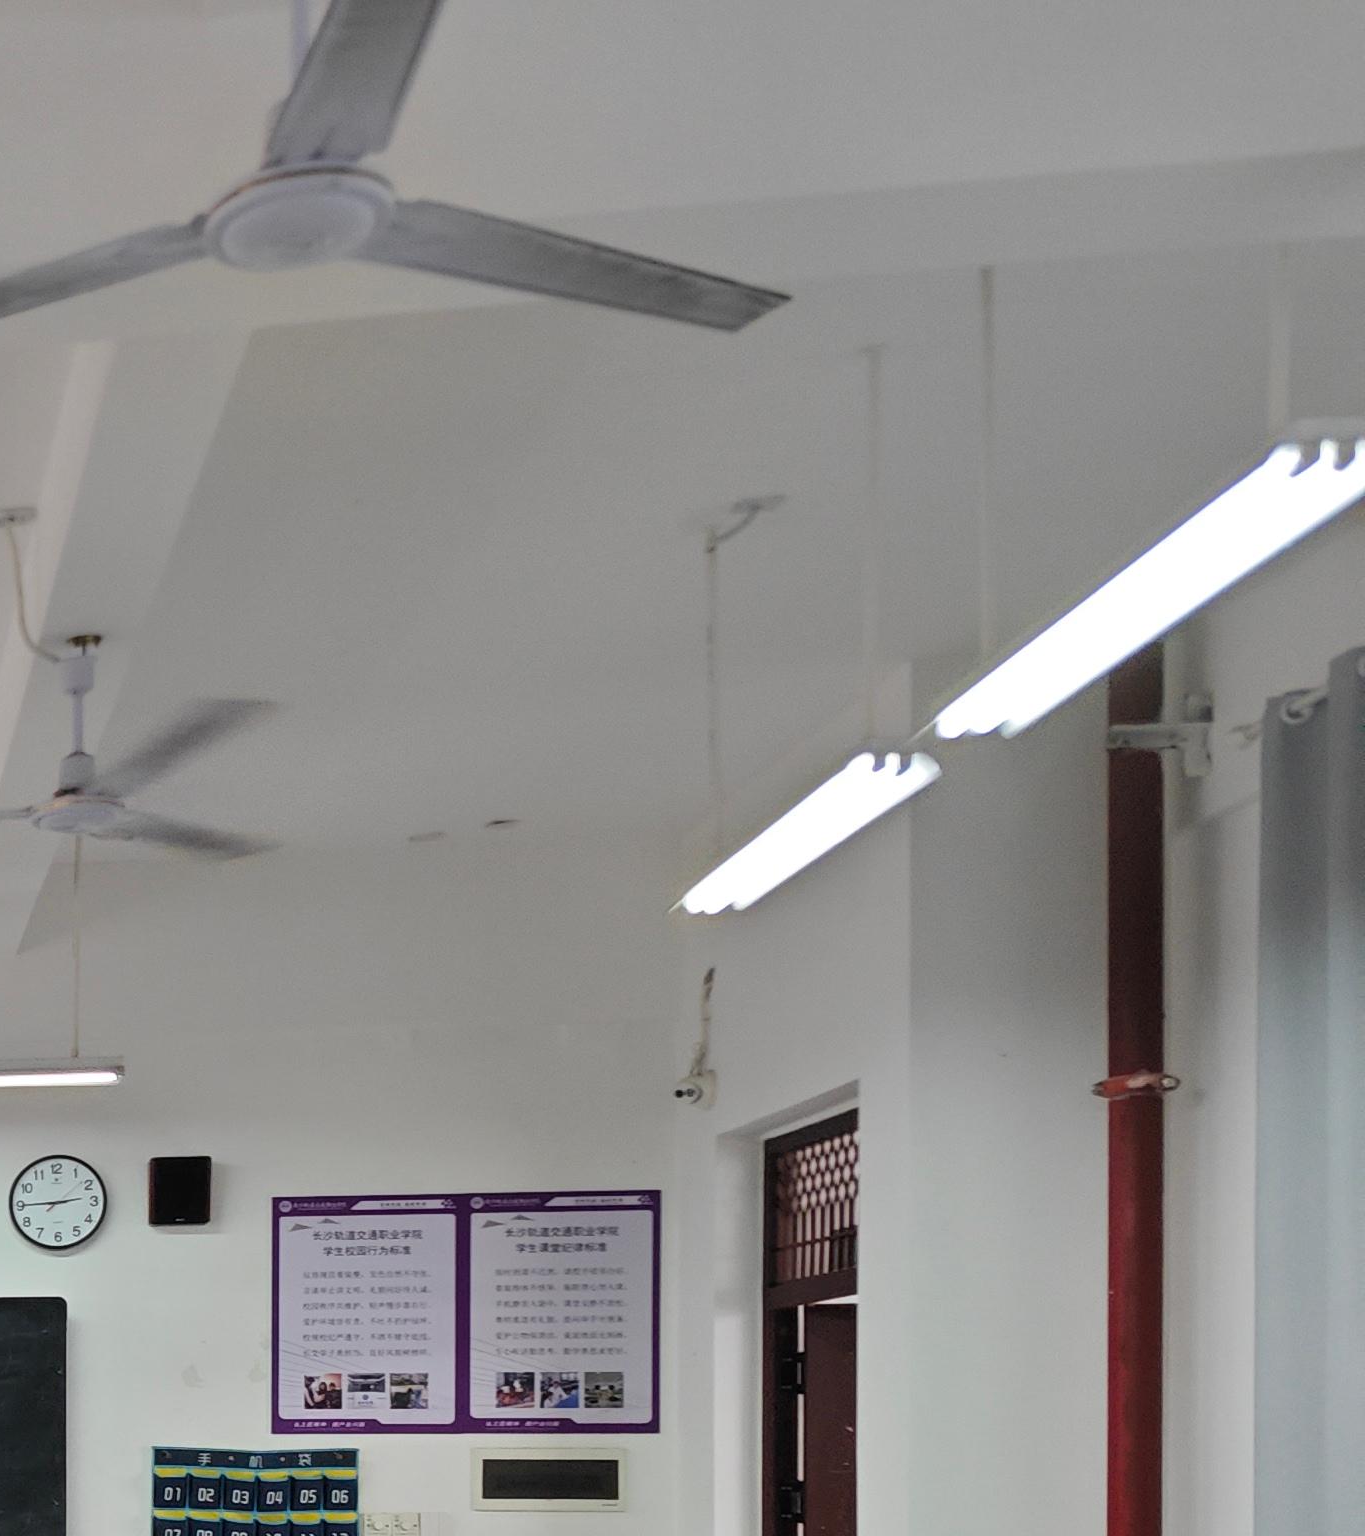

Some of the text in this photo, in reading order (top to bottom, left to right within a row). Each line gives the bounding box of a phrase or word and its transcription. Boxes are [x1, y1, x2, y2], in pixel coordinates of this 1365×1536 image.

[51, 1163, 62, 1174] 12
[74, 1168, 78, 1179] 1
[34, 1169, 44, 1180] 11
[21, 1183, 33, 1194] 10
[84, 1180, 93, 1190] 2
[16, 1200, 24, 1211] 9
[90, 1196, 98, 1207] 3
[23, 1217, 31, 1227] 8
[85, 1214, 93, 1223] 4
[36, 1228, 44, 1238] 7
[73, 1226, 81, 1236] 5
[54, 1232, 62, 1242] 6
[164, 1487, 348, 1504] 01 02 03 04 05 06
